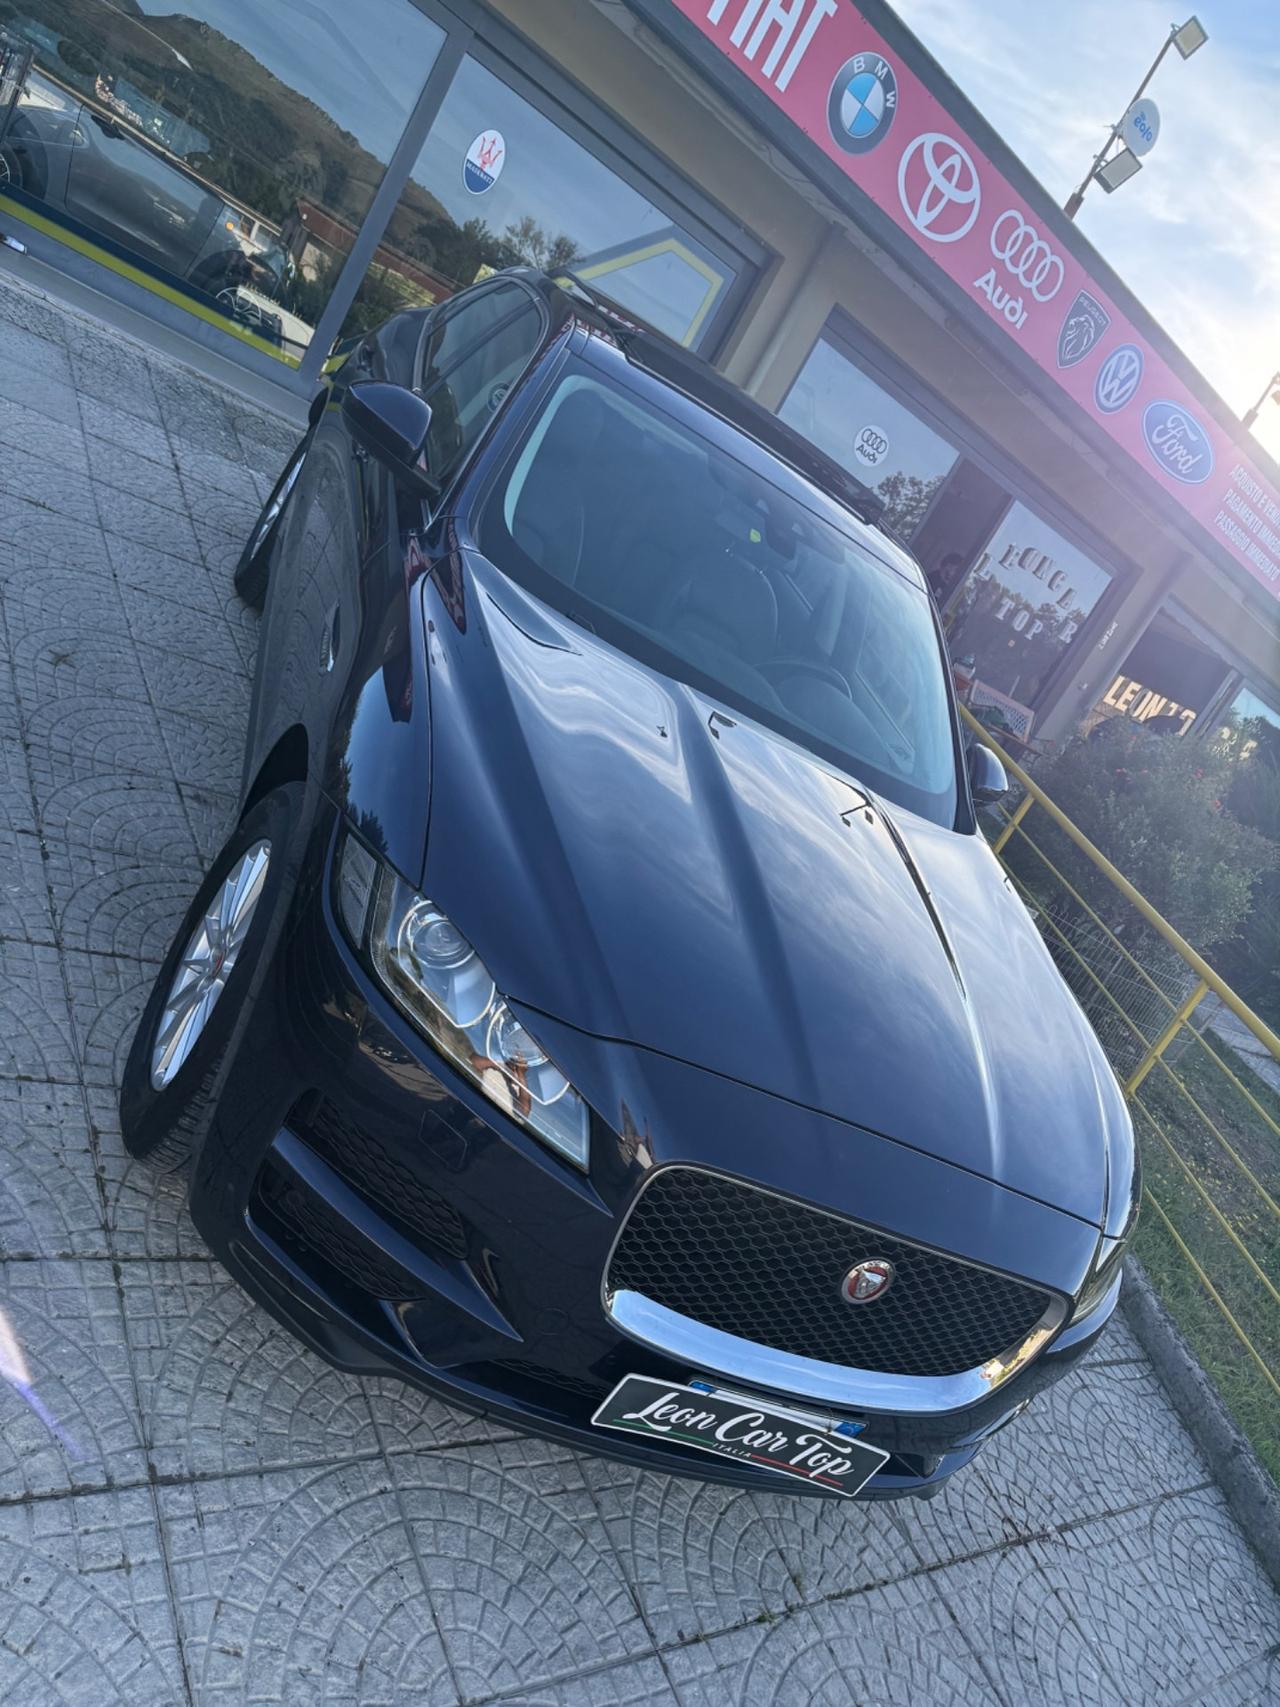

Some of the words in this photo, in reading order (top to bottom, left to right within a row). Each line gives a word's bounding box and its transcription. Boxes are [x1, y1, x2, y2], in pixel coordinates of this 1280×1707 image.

[706, 0, 838, 93] IAT
[852, 57, 895, 107] BMW
[1152, 414, 1202, 474] Ford
[996, 597, 1043, 640] TOP
[622, 1392, 717, 1431] Leon
[714, 1412, 788, 1453] Car
[788, 1433, 855, 1478] Top
[711, 1442, 752, 1458] ITALIA
